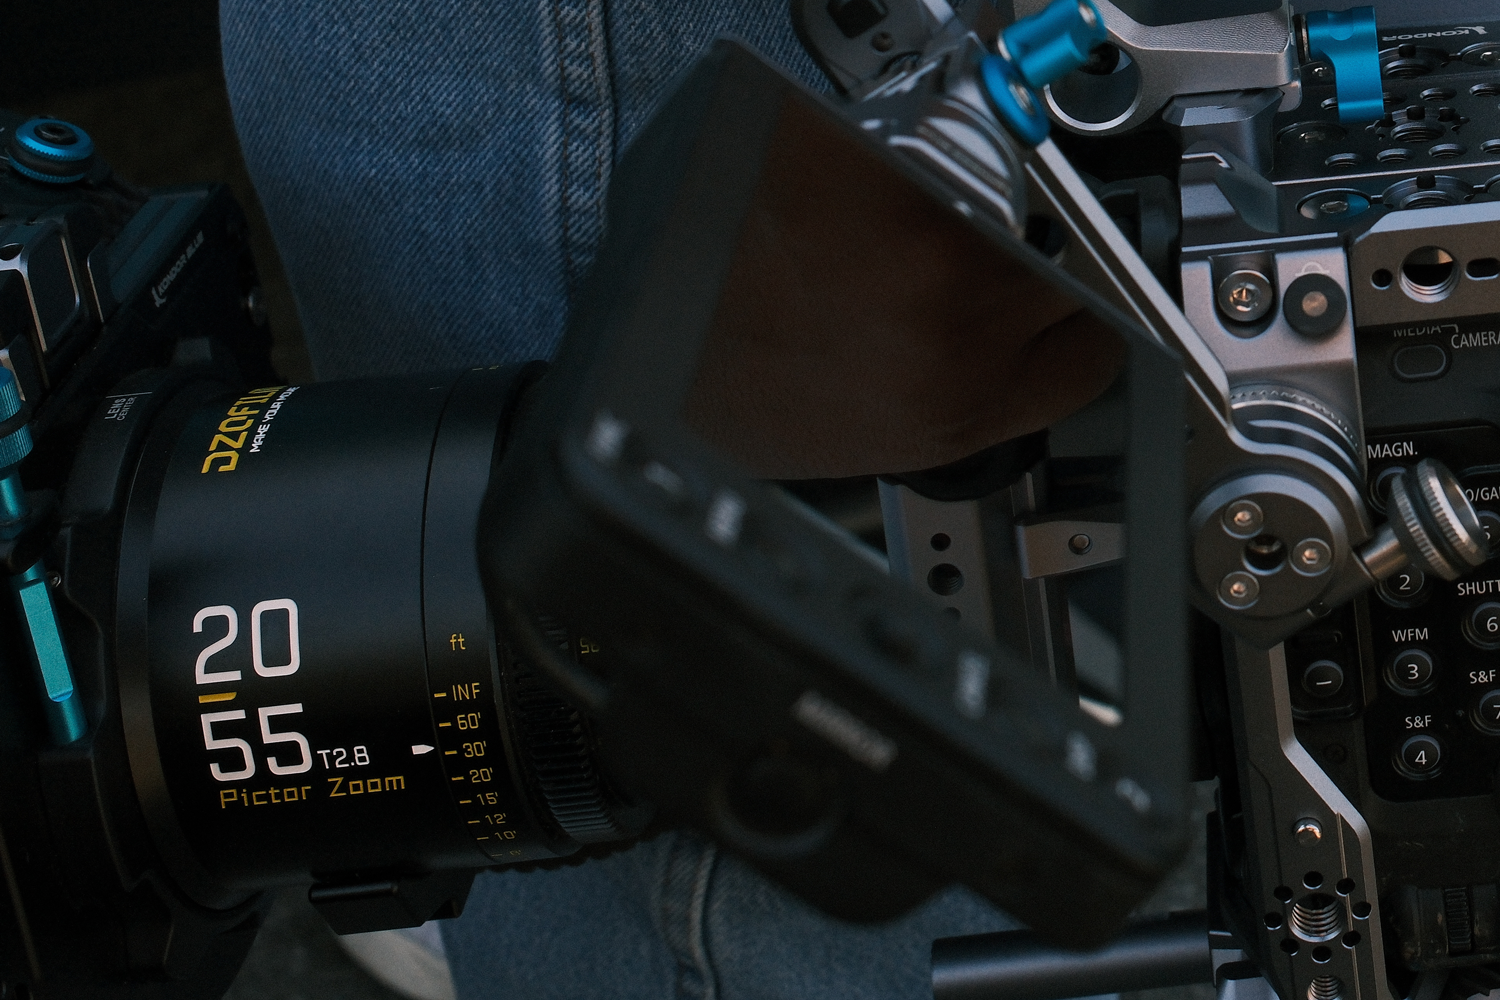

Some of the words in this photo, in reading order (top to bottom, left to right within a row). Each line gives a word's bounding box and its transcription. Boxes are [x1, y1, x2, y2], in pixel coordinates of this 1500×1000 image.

[1382, 29, 1470, 42] KONDOR
[104, 398, 126, 420] LENS
[116, 396, 138, 421] CENTER
[248, 423, 271, 453] MAKE
[262, 400, 284, 422] YOUR
[1366, 440, 1418, 459] MAGN.
[1398, 574, 1412, 590] 2
[1486, 616, 1499, 632] 6
[192, 598, 300, 684] 20
[450, 634, 466, 650] ft
[1392, 626, 1430, 642] WFM
[1407, 664, 1420, 680] 3
[1469, 670, 1496, 685] S&F
[452, 682, 480, 702] INF
[456, 712, 482, 730] 60'
[1405, 714, 1432, 730] S&F
[200, 702, 313, 782] 55
[462, 740, 487, 758] 30'
[316, 744, 370, 770] T2.8
[1415, 750, 1428, 766] 4
[469, 766, 494, 784] 20'
[220, 786, 312, 810] Pictor
[327, 774, 406, 798] Zoom
[476, 792, 498, 806] 15'
[485, 812, 506, 826] 12'
[494, 830, 517, 841] 10'
